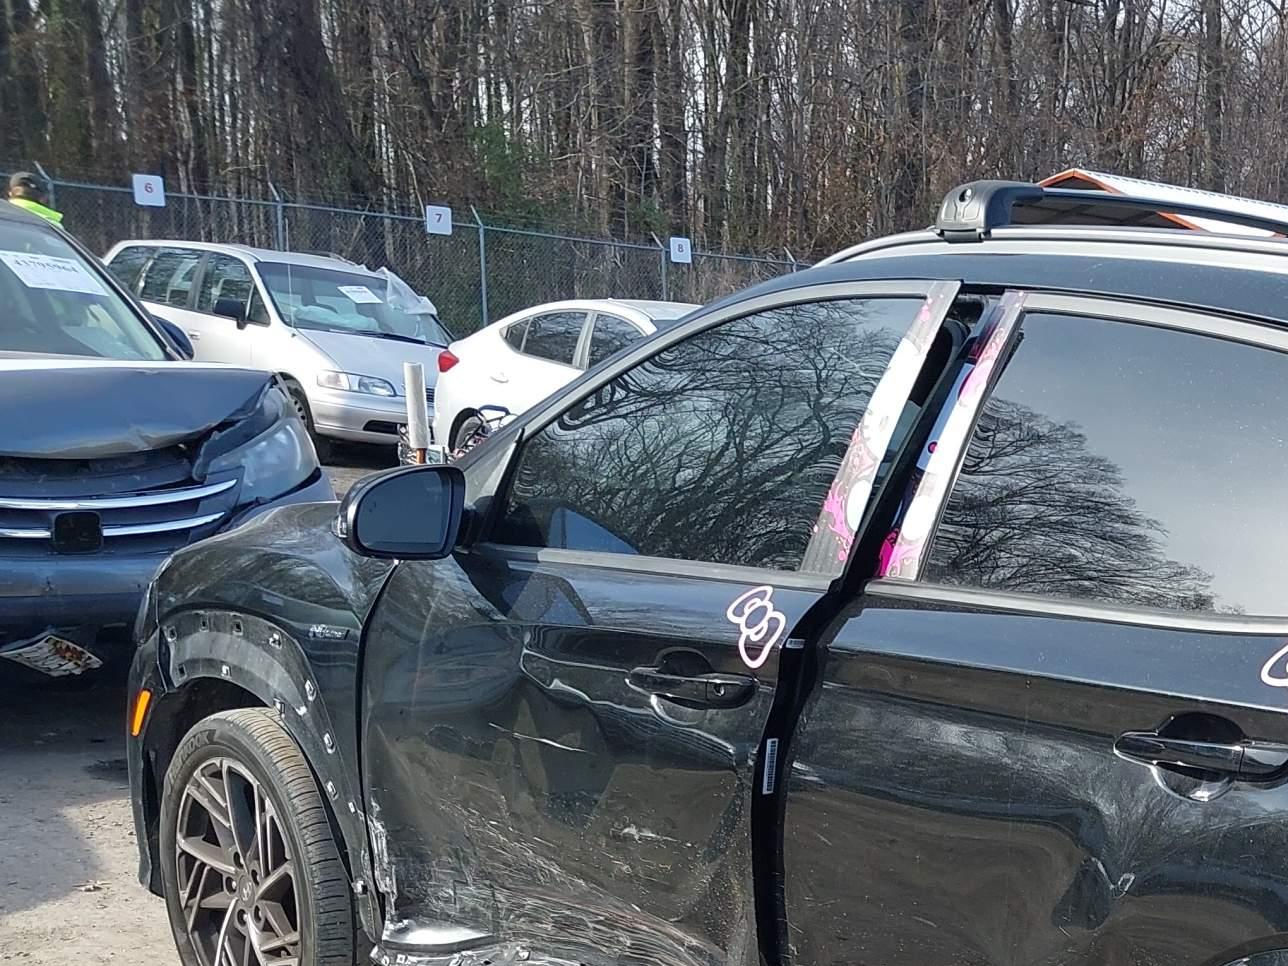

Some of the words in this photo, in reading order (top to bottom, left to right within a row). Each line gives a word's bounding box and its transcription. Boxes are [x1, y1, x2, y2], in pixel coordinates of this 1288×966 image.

[144, 182, 154, 194] 6
[435, 213, 443, 223] 7
[677, 243, 684, 253] 8
